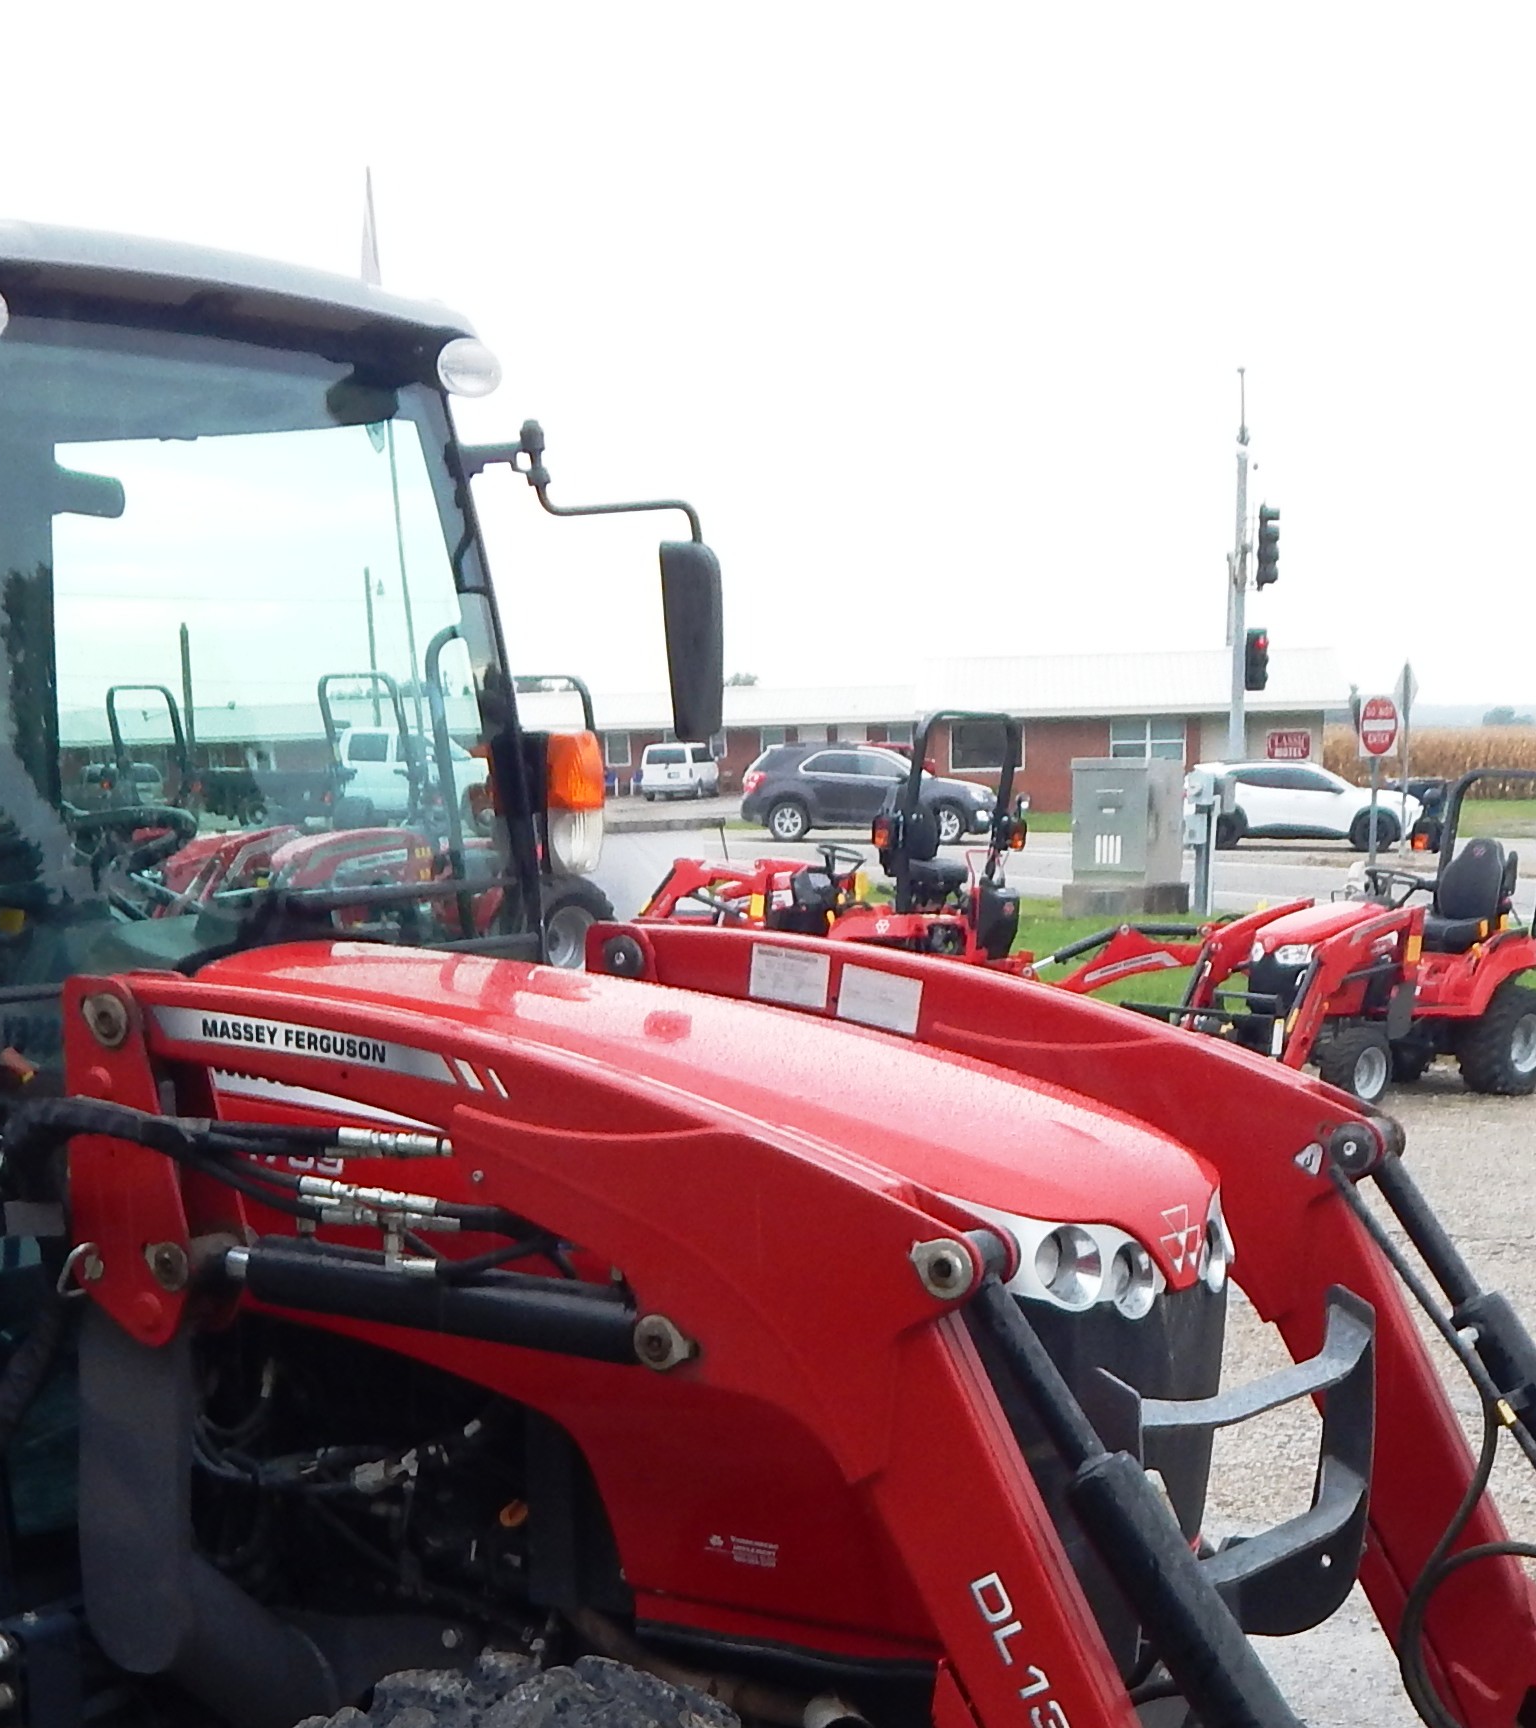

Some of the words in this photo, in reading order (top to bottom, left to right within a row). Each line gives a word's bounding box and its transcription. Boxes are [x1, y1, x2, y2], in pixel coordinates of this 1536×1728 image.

[1268, 731, 1308, 752] CLASSIC
[1274, 747, 1303, 757] MOTEL
[201, 1018, 278, 1046] MASSEY
[284, 1029, 386, 1064] FERGUSON
